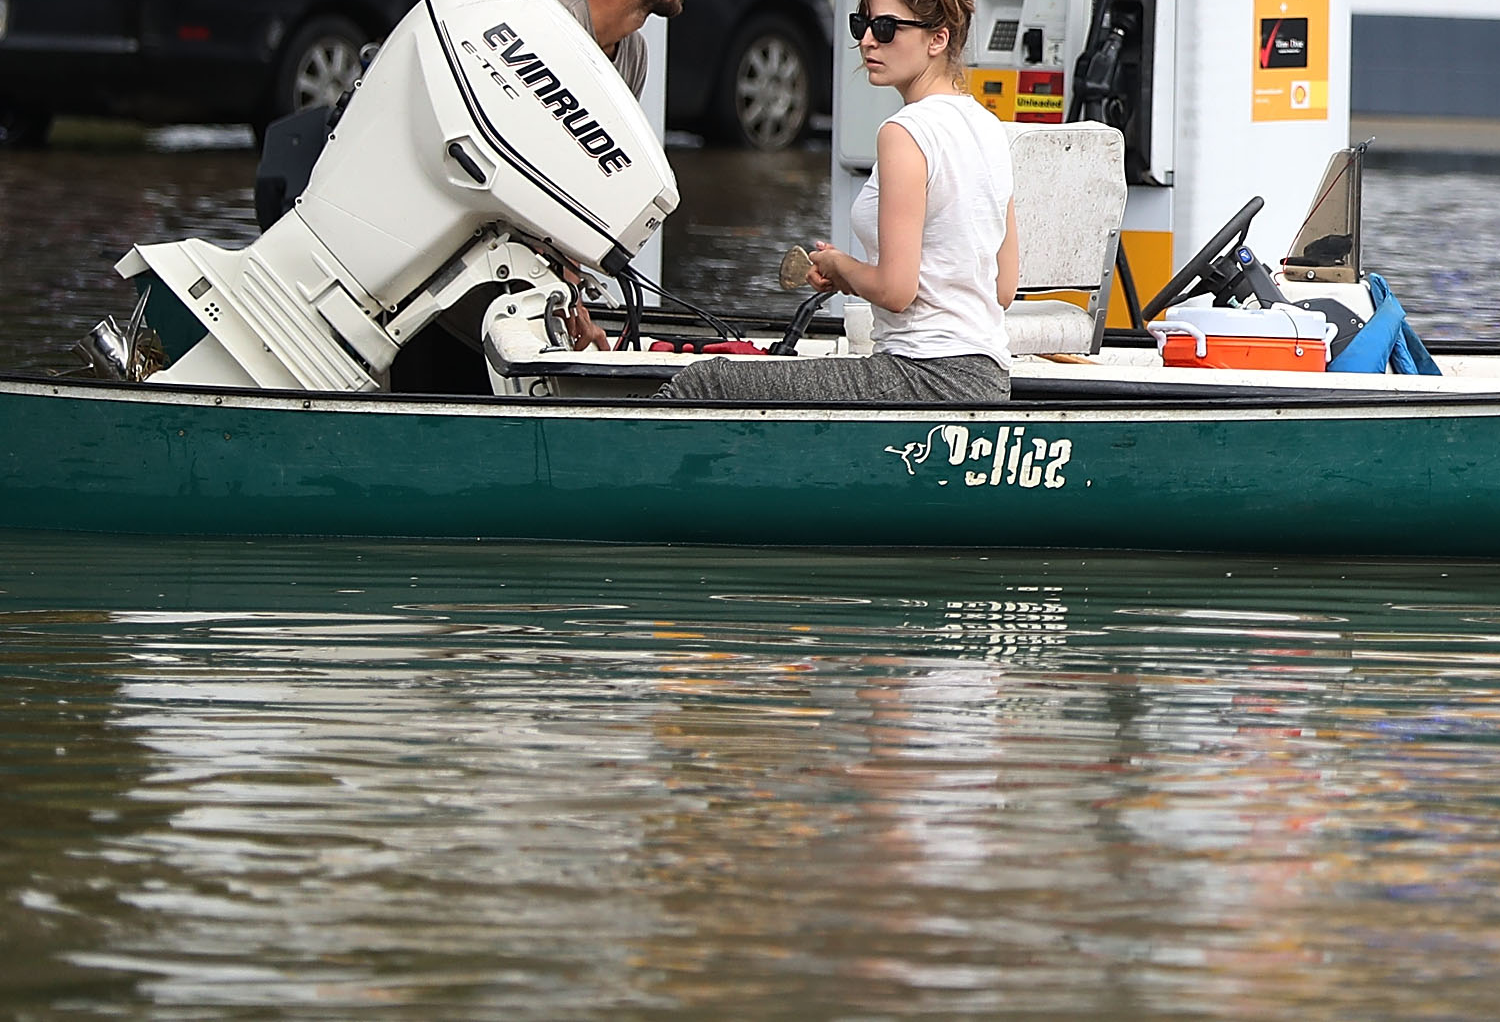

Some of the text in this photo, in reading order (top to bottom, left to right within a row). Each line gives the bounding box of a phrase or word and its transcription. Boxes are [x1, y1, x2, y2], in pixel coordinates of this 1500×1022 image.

[461, 40, 520, 100] E-TEC
[482, 22, 633, 178] EVINRUDE
[1017, 97, 1062, 109] Unleaded
